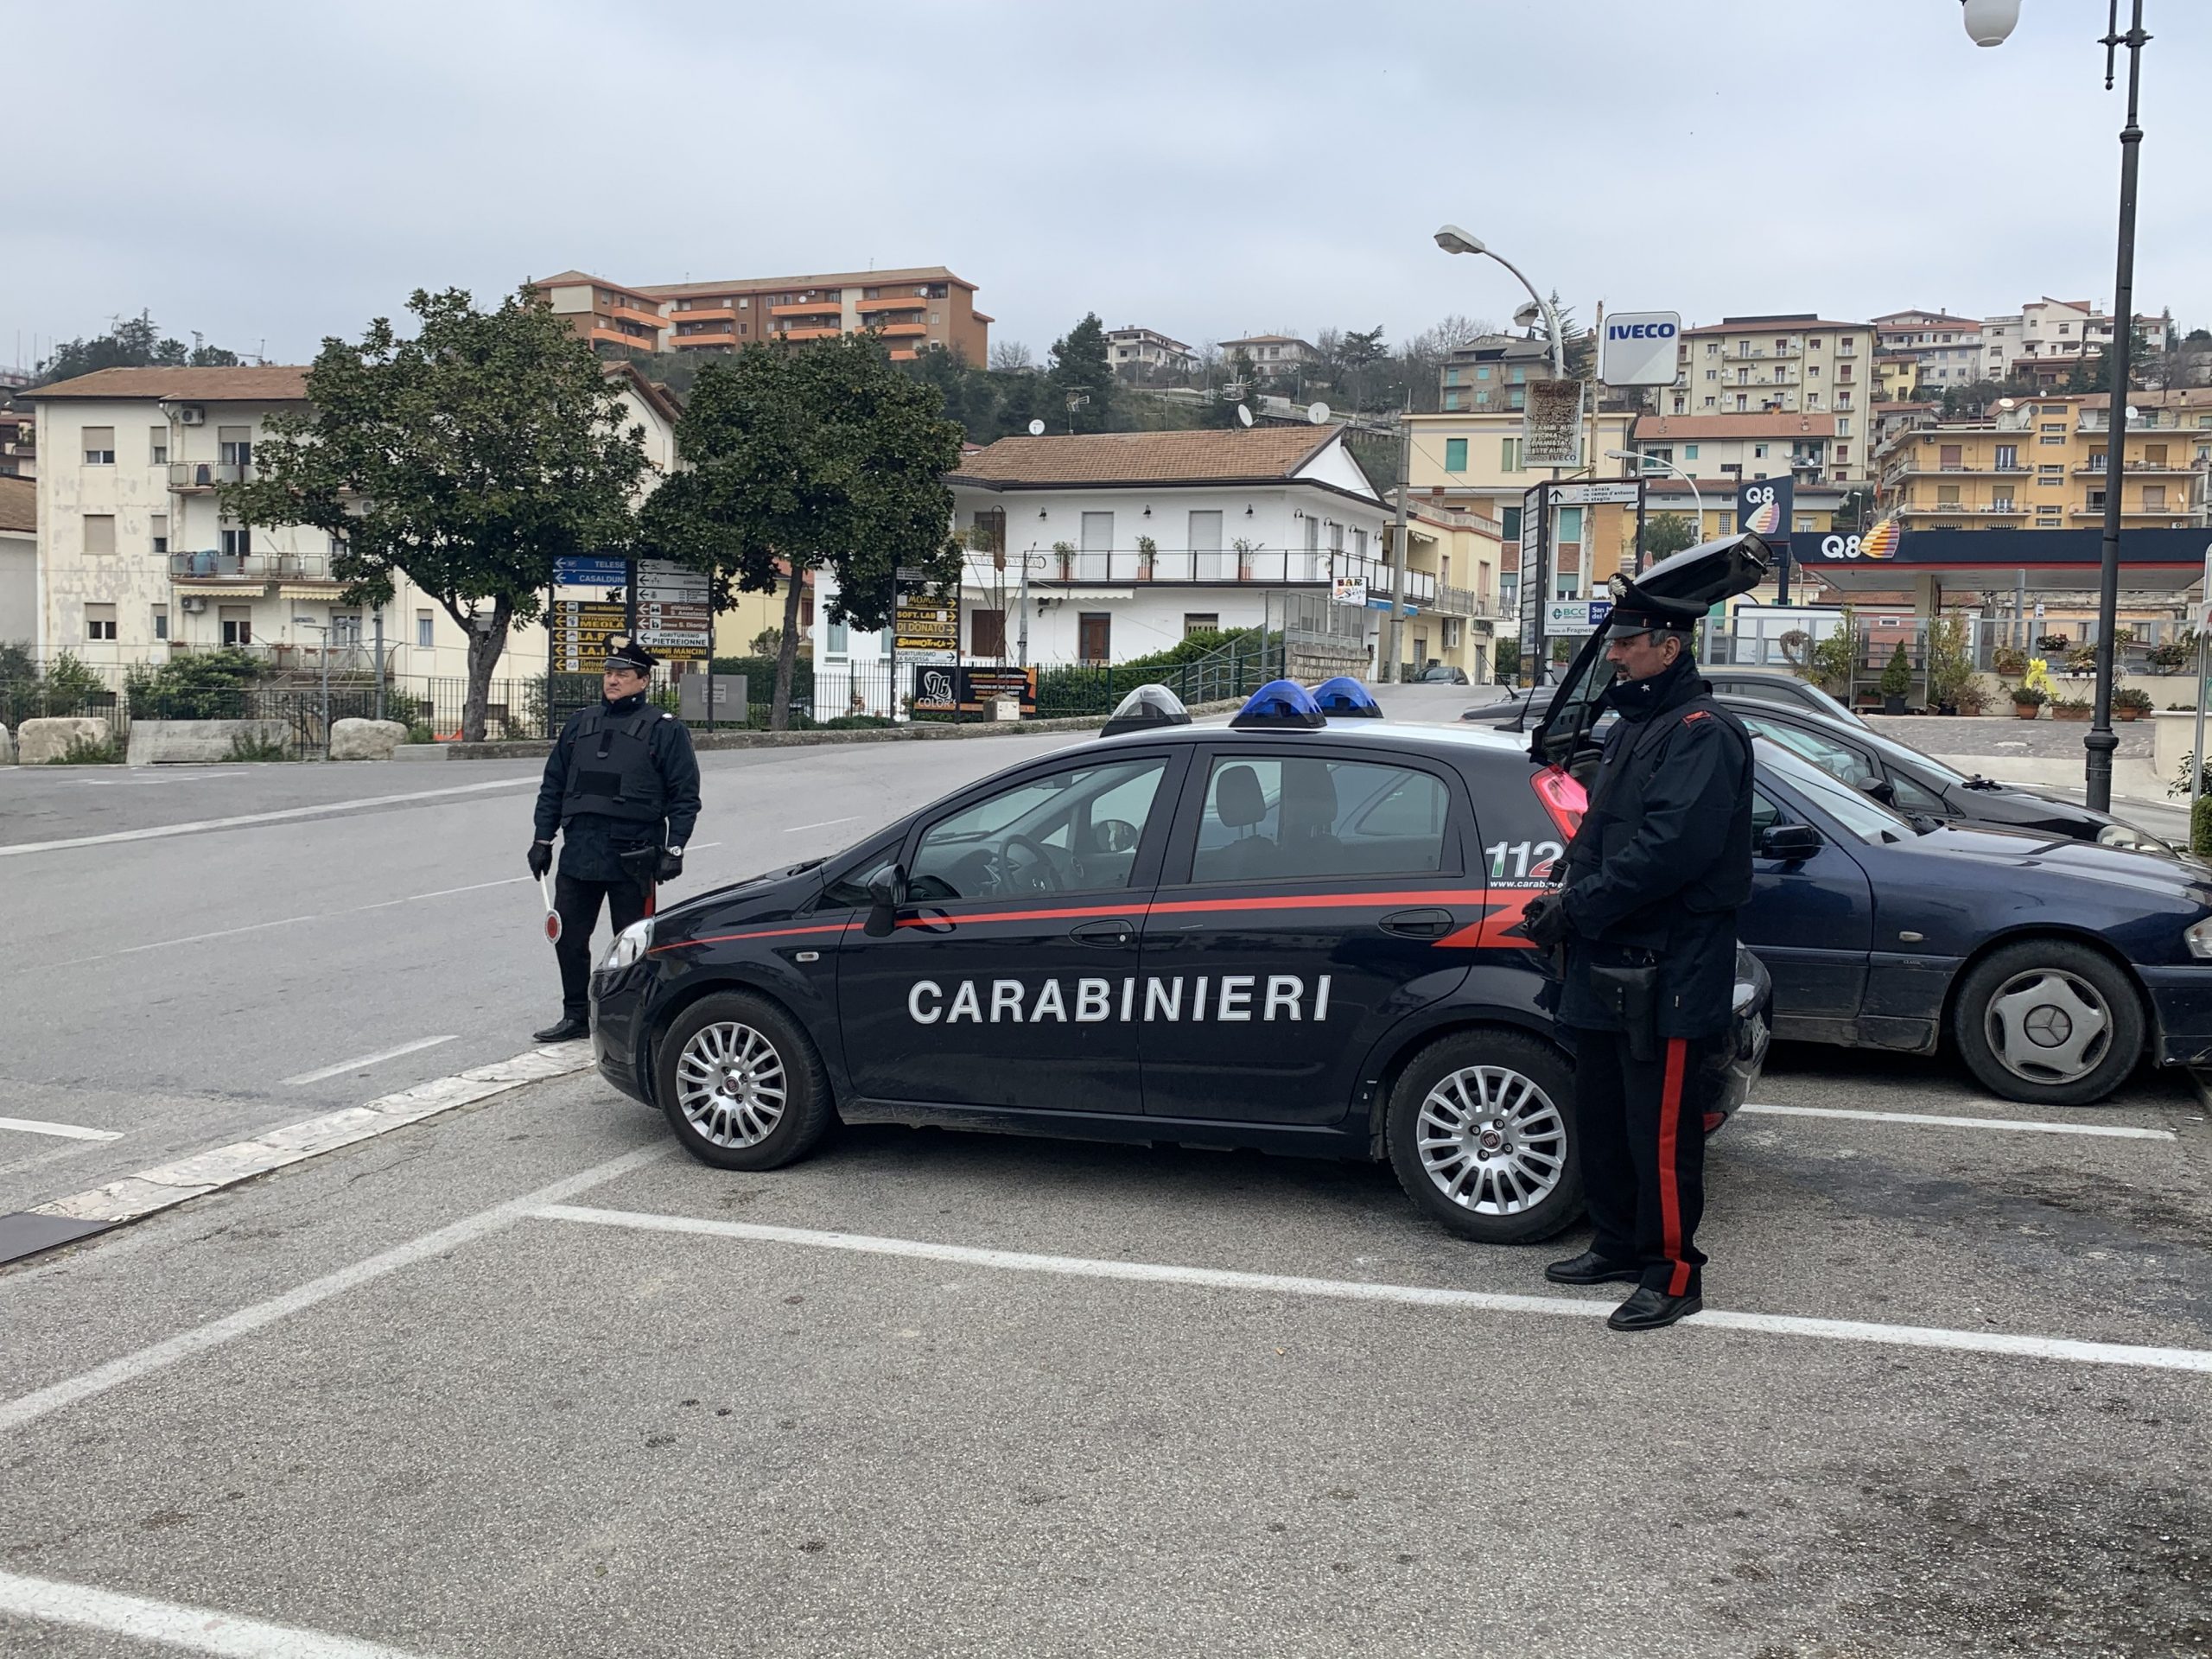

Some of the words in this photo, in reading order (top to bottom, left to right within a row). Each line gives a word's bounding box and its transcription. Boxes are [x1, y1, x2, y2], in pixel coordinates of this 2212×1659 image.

[1609, 322, 1675, 340] IVECO
[1745, 486, 1775, 504] Q8
[1821, 535, 1861, 559] Q8
[579, 575, 626, 583] CASALDUNI
[1563, 607, 1586, 616] BCC
[897, 623, 906, 632] DI
[1485, 841, 1564, 878] 112
[907, 975, 1332, 1025] CARABINIERI
